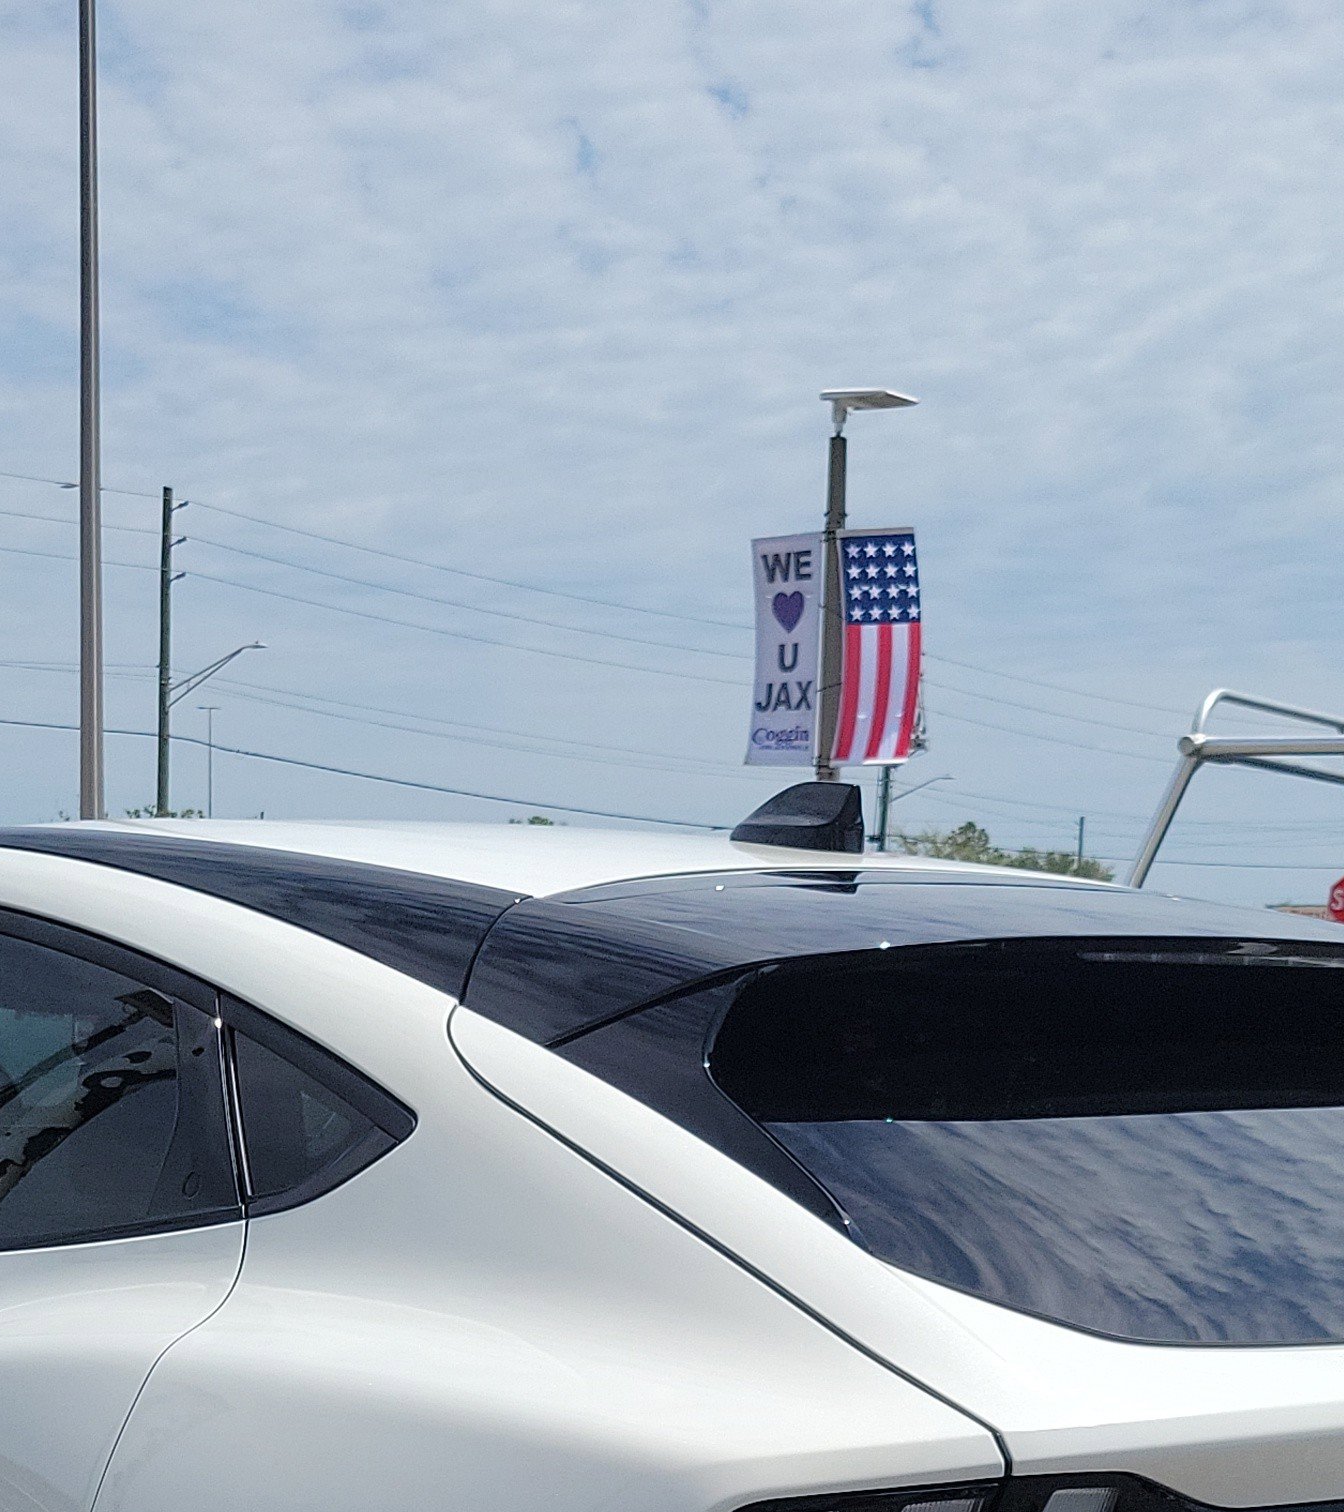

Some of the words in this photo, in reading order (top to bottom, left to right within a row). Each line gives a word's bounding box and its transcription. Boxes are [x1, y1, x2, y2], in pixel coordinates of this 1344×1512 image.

[761, 550, 812, 583] WE
[777, 642, 799, 673] U
[756, 680, 813, 713] JAX
[752, 726, 809, 746] Coggin
